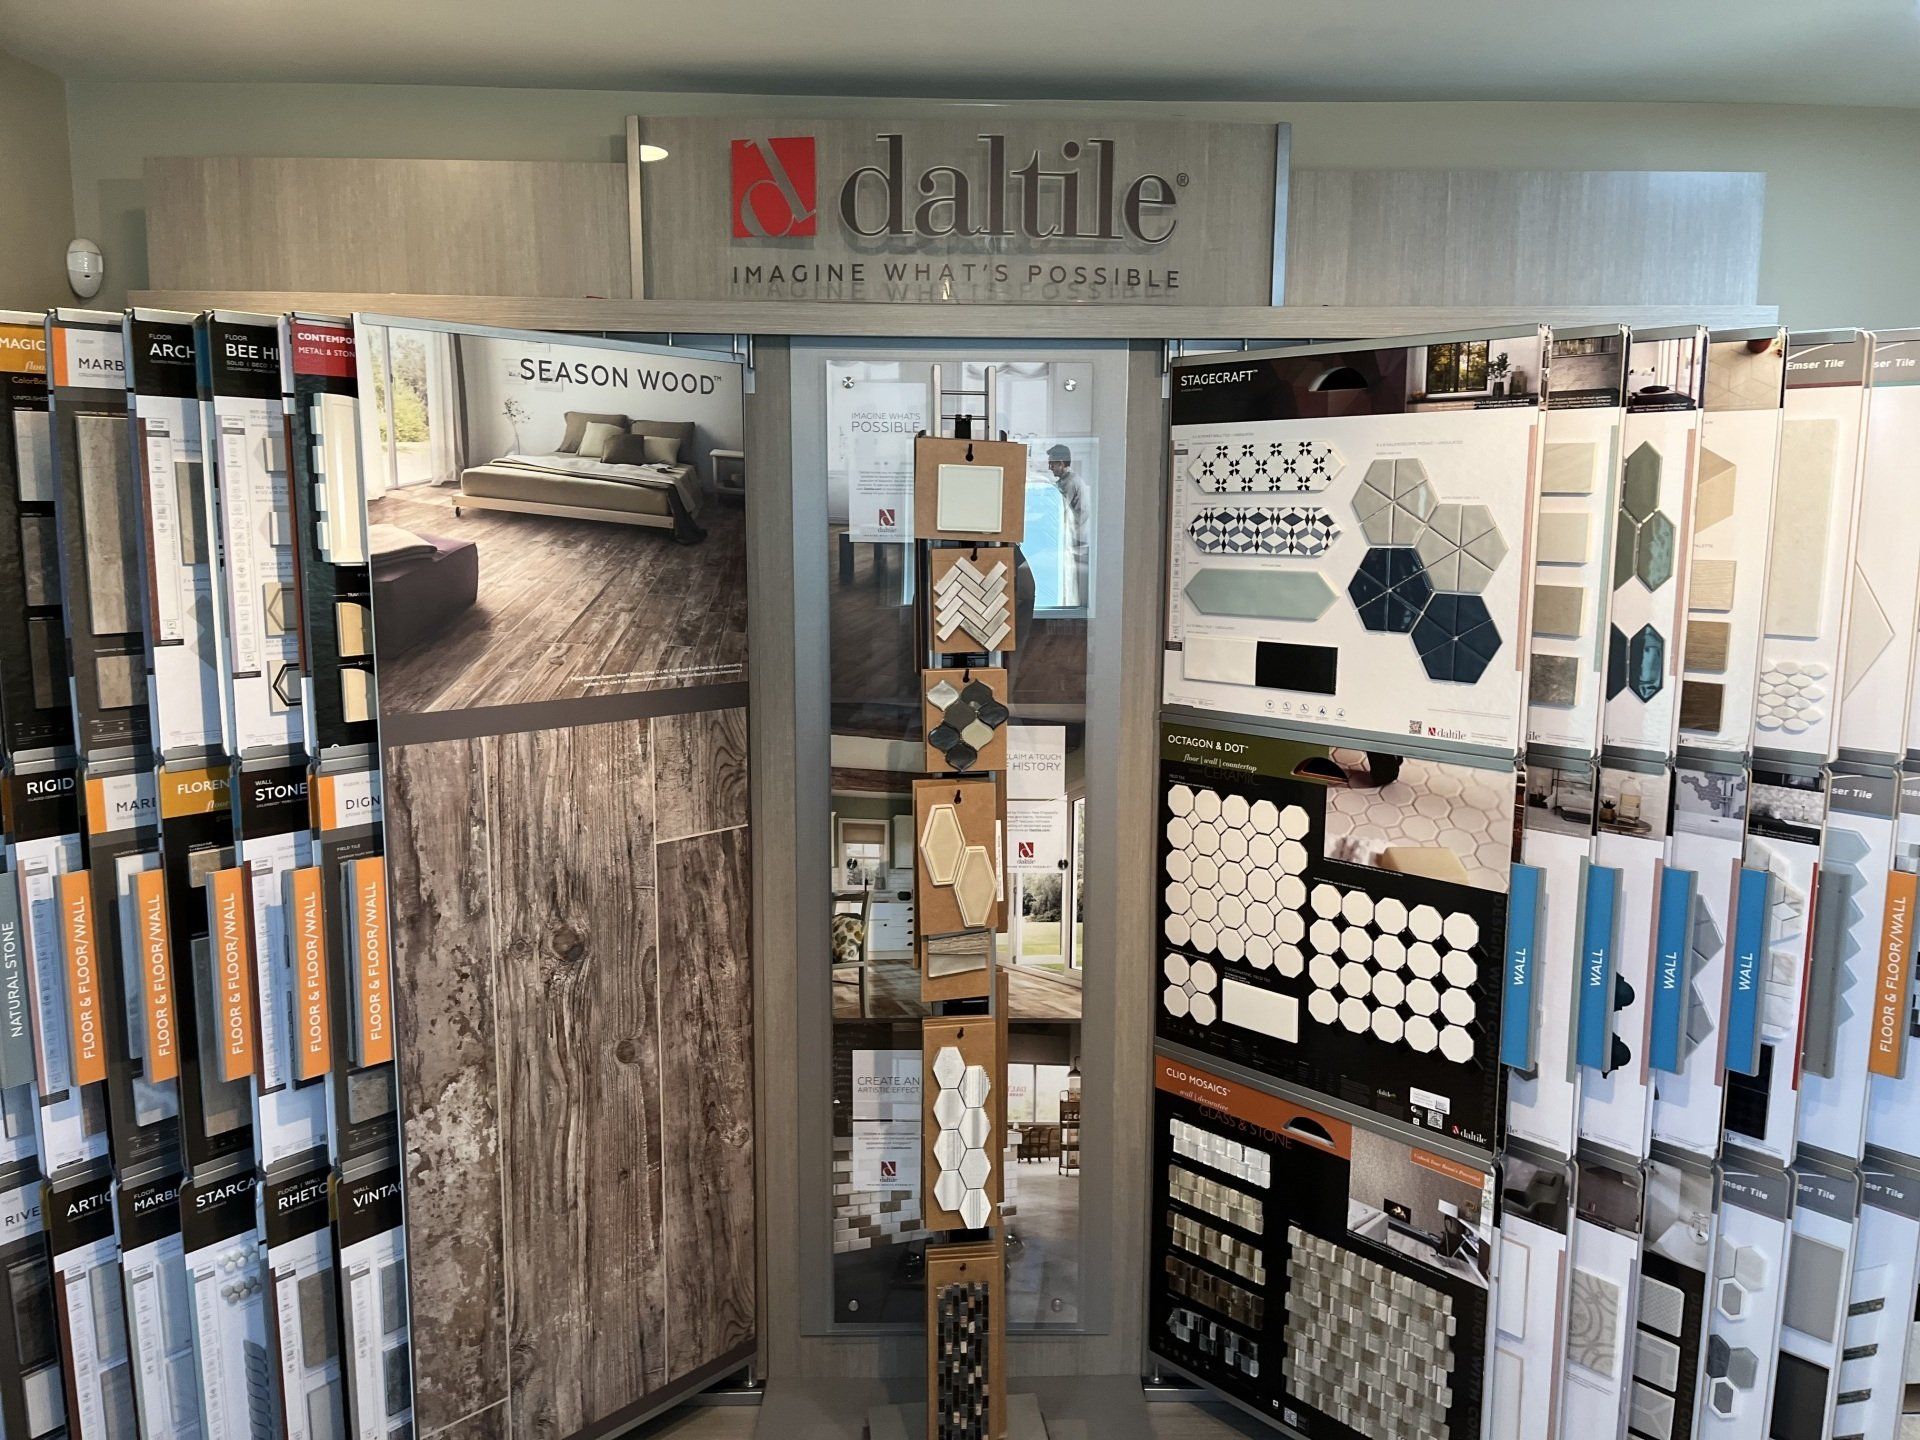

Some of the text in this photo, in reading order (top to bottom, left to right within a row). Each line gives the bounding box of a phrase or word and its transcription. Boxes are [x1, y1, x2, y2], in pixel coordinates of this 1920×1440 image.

[733, 263, 1180, 288] IMAGINE WHAT'S POSSIBLE
[226, 343, 259, 359] BEE
[298, 347, 323, 355] METAL
[1786, 359, 1845, 370] Emser Tile
[1895, 358, 1916, 368] Tile
[519, 358, 629, 388] SEASON
[851, 412, 921, 420] IMAGINE WHAT'S
[851, 421, 920, 433] POSSIBLE
[1167, 735, 1214, 749] OCTAGON
[1215, 741, 1222, 751] &
[1183, 753, 1199, 762] floor
[1203, 757, 1218, 765] wall
[1222, 761, 1257, 773] countertop
[26, 777, 75, 795] RIGID
[255, 782, 308, 801] STONE
[1853, 789, 1873, 799] Tile
[345, 795, 381, 809] DIGN
[365, 881, 382, 1041] FLOOR & FLOOR/WALL
[1513, 948, 1526, 986] WALL
[1590, 948, 1603, 987] WALL
[72, 896, 95, 1059] FLOOR & FLOOR/WALL
[148, 894, 170, 1057] FLOOR & FLOOR/WALL
[224, 893, 243, 1055] FLOOR & FLOOR/WALL
[304, 892, 322, 1053] FLOOR & FLOOR/WALL
[1664, 950, 1677, 990] WALL
[1739, 953, 1753, 991] WALL
[1880, 896, 1906, 1053] FLOOR & FLOOR/WALL
[2, 921, 23, 1038] NATURAL STONE
[857, 1077, 920, 1086] CREATE AN
[1166, 1067, 1187, 1081] CLIO
[1199, 1104, 1236, 1128] GLASS
[1250, 1126, 1293, 1149] STONE
[133, 1188, 155, 1199] FLOOR
[277, 1184, 298, 1195] FLOOR
[352, 1185, 370, 1195] WALL
[1750, 1187, 1768, 1200] Tile
[1817, 1188, 1836, 1201] Tile
[1885, 1186, 1904, 1200] Tile
